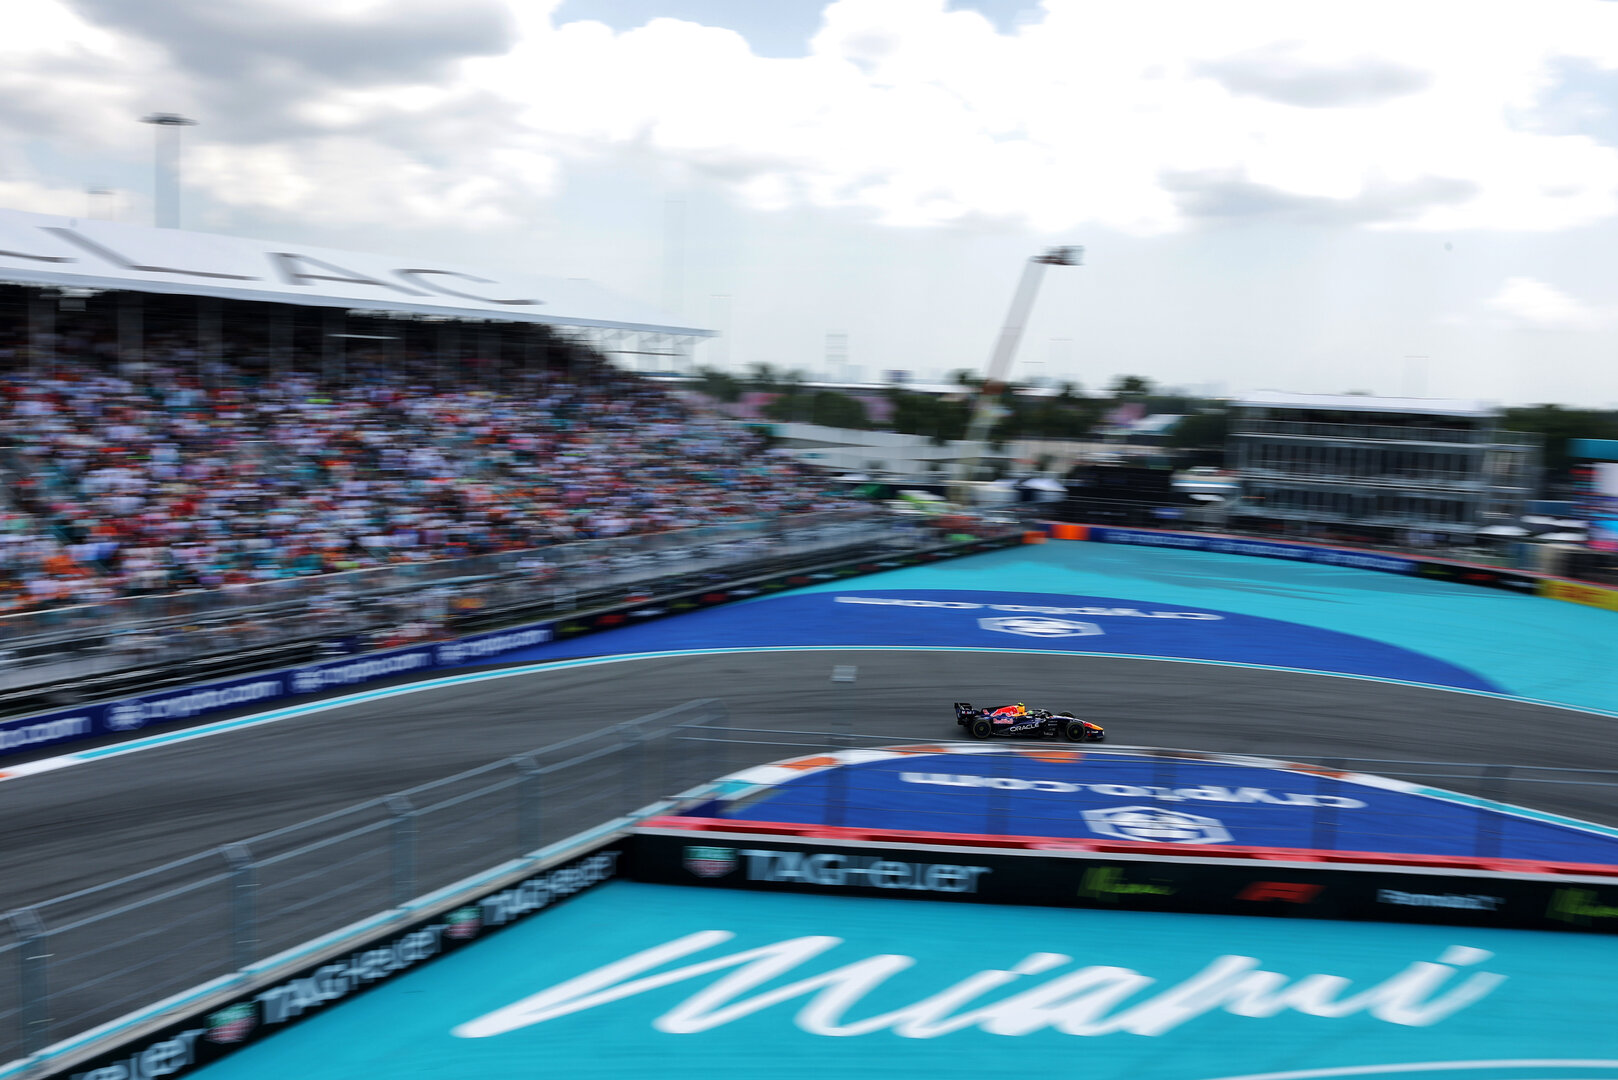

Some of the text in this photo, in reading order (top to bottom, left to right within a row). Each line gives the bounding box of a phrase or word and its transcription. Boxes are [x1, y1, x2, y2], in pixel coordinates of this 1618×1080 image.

[1010, 722, 1040, 732] ORACLE
[900, 771, 1367, 809] crypto.com
[452, 930, 1508, 1041] Miami
